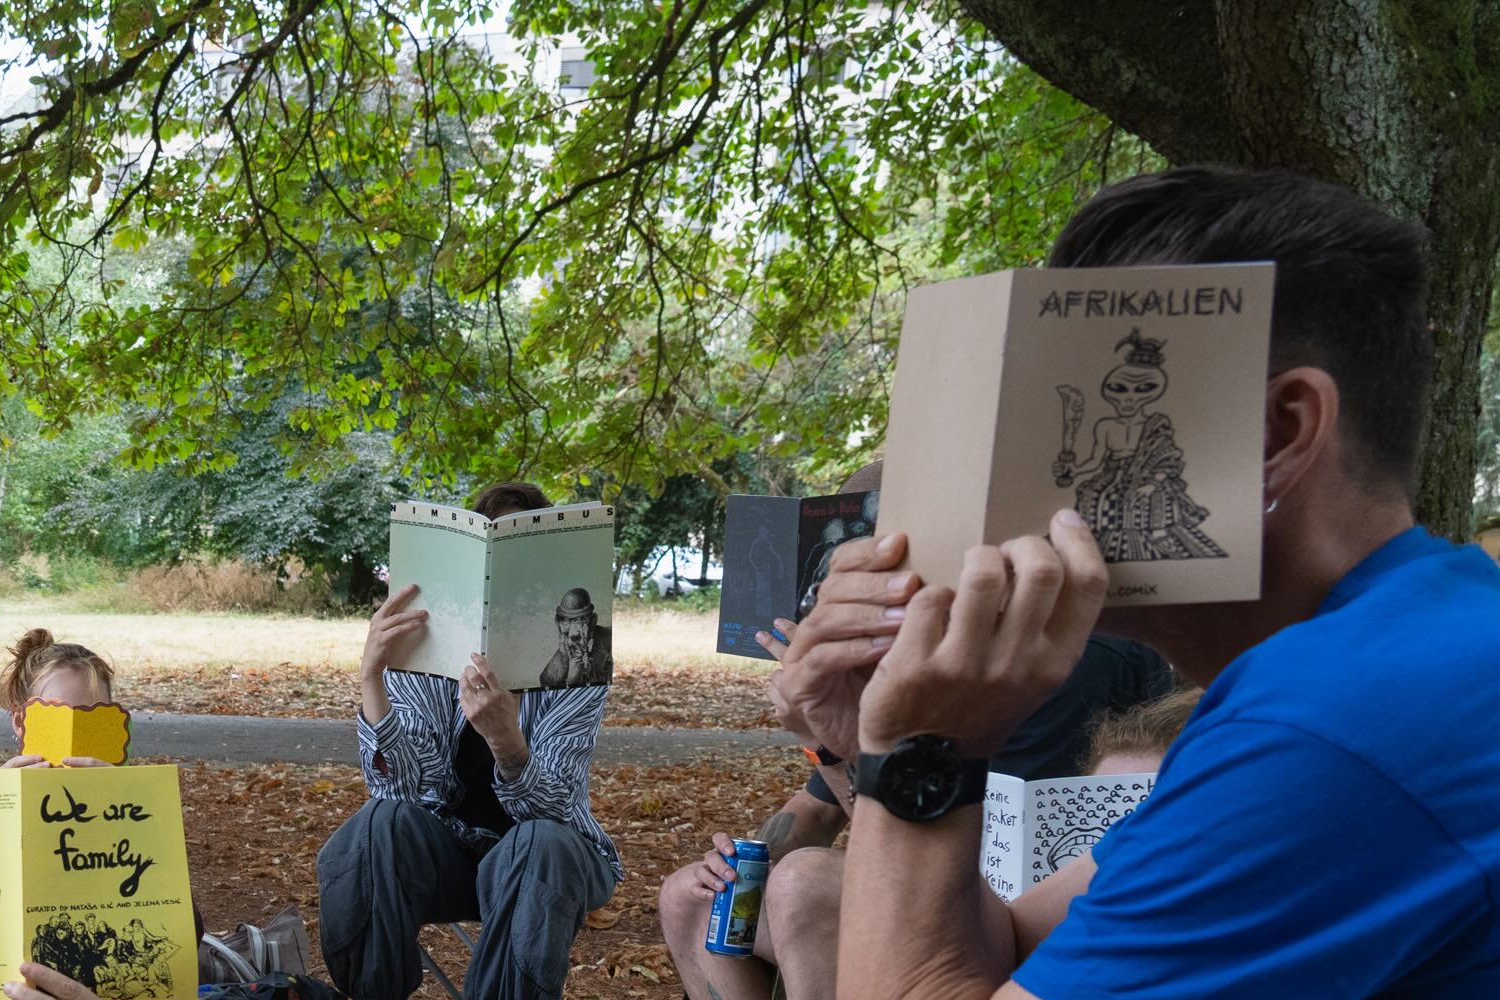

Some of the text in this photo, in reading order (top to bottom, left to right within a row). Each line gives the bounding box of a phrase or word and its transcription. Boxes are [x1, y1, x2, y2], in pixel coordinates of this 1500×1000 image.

[1039, 287, 1243, 318] AFRIKALIEN
[493, 507, 614, 531] NIMBUS
[40, 785, 98, 824] We
[103, 803, 153, 821] are
[992, 832, 1011, 852] das
[54, 828, 157, 898] family
[987, 851, 1002, 867] ist
[26, 905, 57, 913] CURATED
